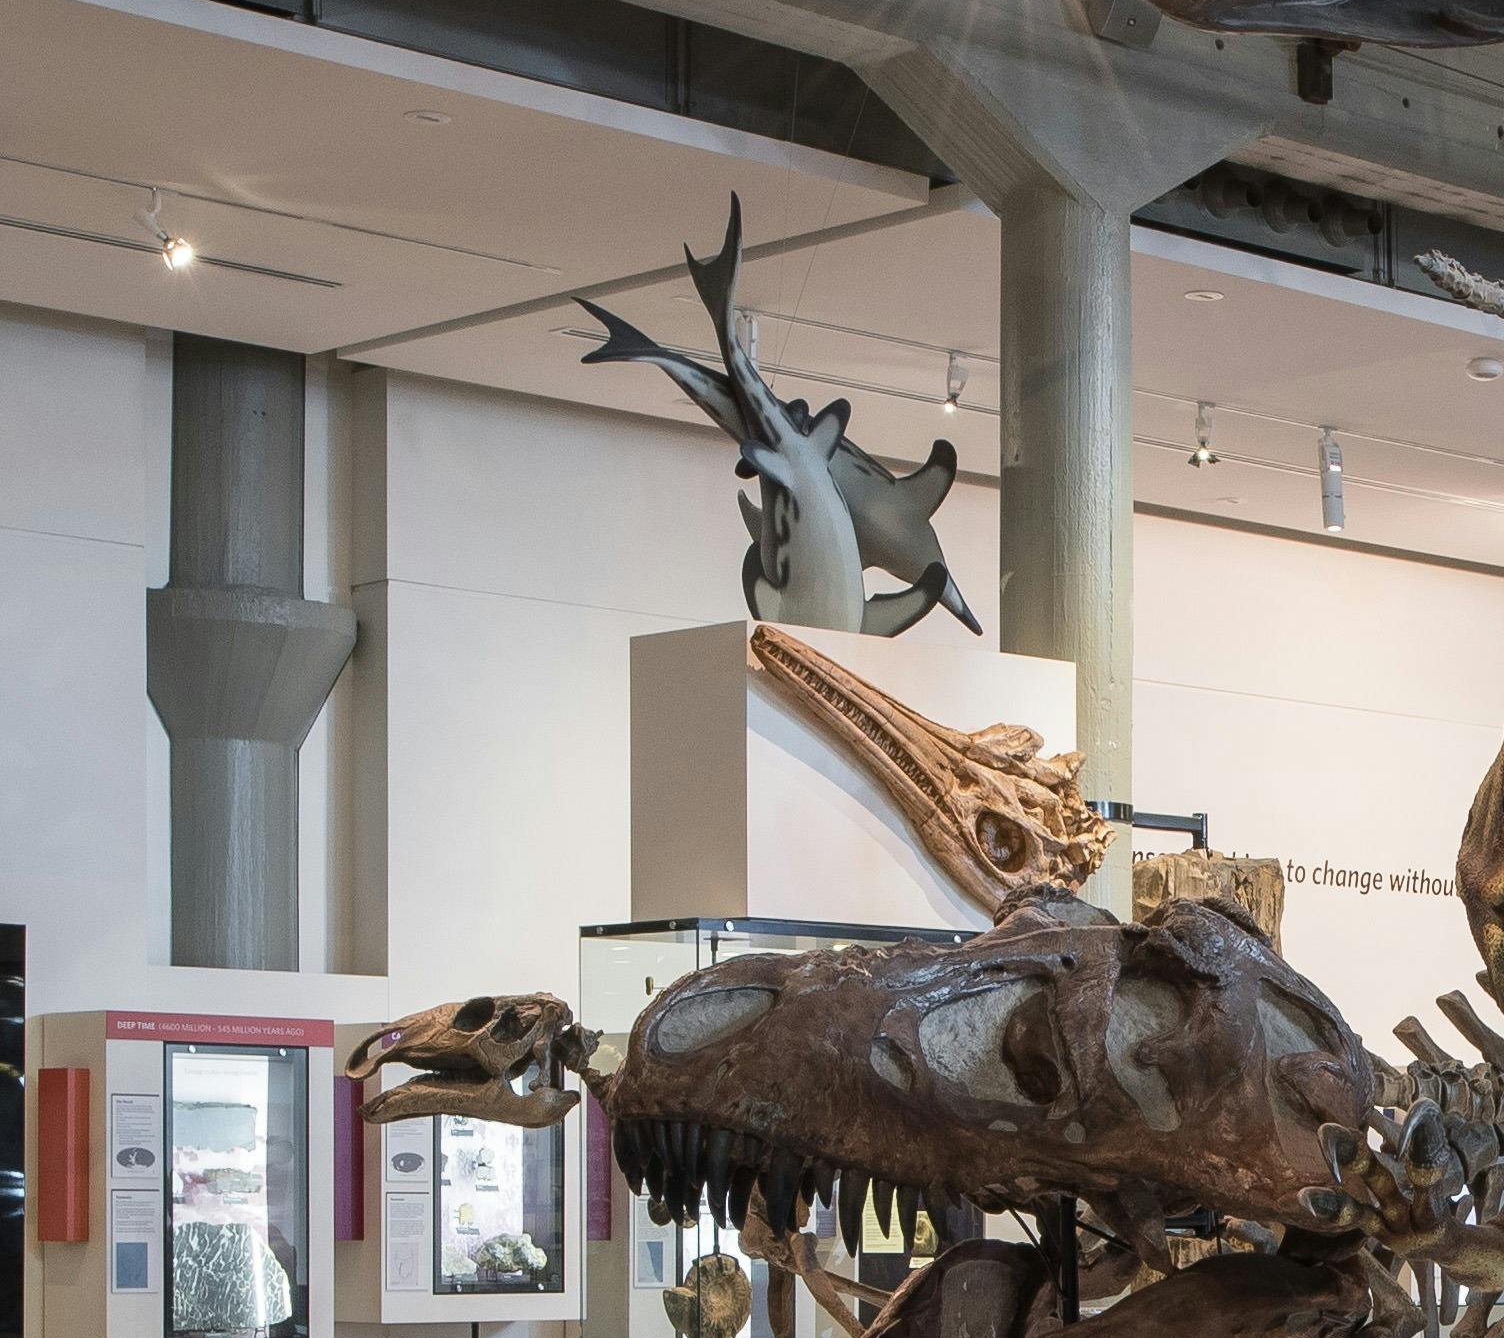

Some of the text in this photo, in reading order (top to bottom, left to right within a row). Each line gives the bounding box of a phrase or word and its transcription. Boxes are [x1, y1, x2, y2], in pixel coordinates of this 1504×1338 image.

[1286, 859, 1454, 897] to change withou
[118, 1020, 136, 1030] DEEP
[137, 1021, 155, 1030] TIME
